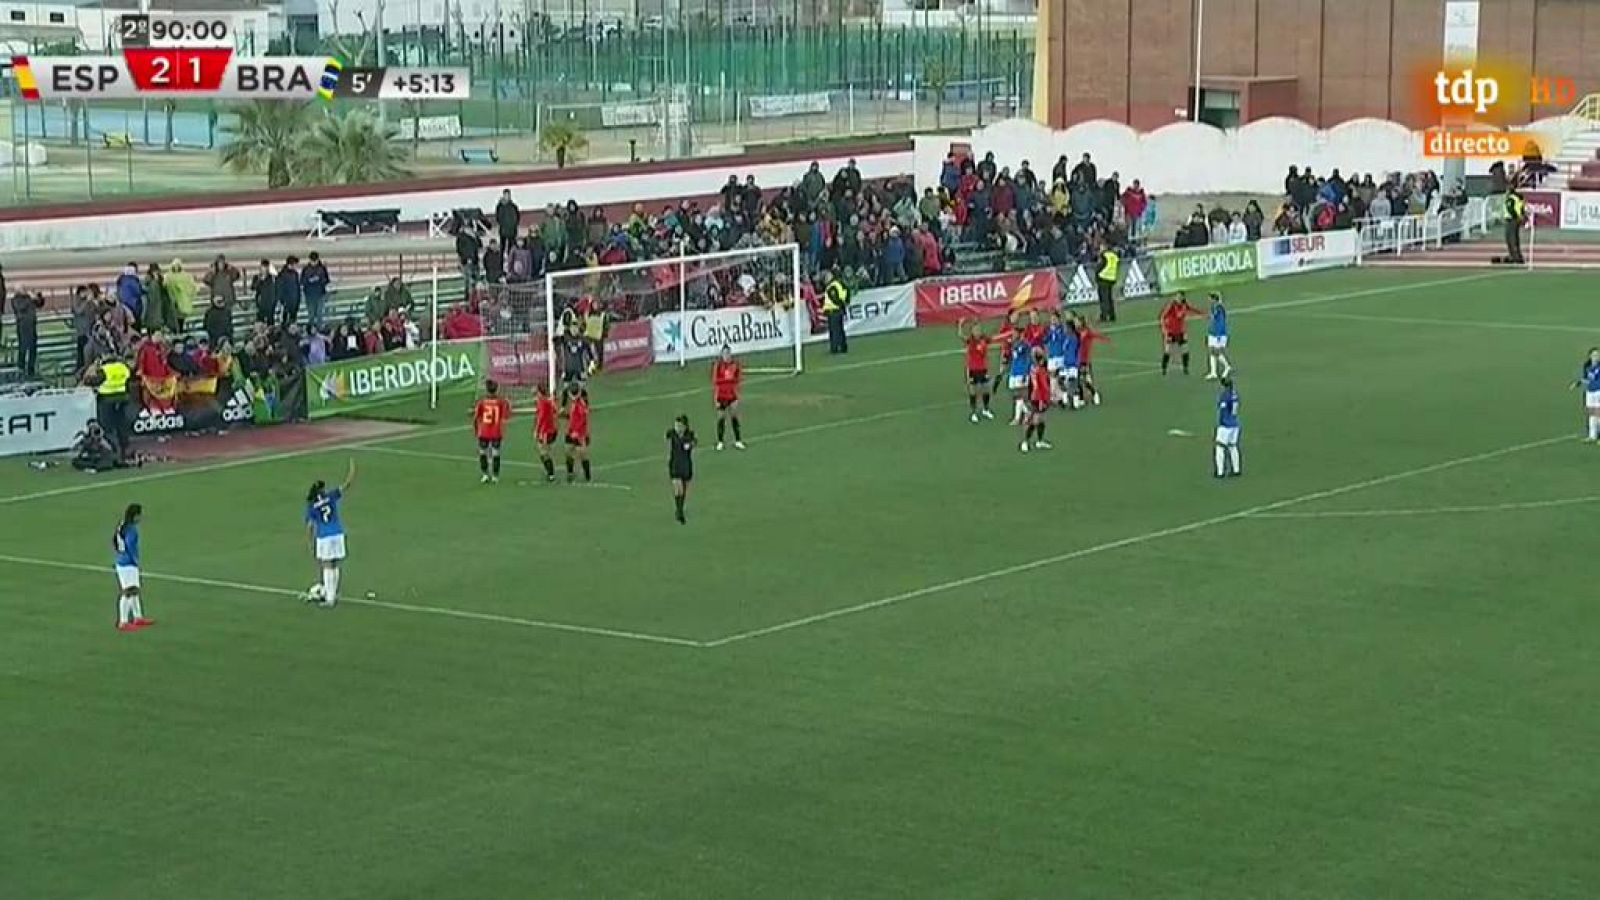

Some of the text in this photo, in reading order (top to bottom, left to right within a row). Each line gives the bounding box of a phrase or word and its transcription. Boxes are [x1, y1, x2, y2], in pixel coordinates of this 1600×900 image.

[1292, 236, 1326, 252] SEUR
[1178, 250, 1254, 278] IBERDROLA
[939, 281, 1008, 306] IBERIA
[849, 299, 895, 321] EAT
[691, 309, 783, 347] CaixaBank
[350, 353, 475, 396] IBERDROLA
[133, 414, 184, 433] adidas
[482, 404, 500, 423] 21
